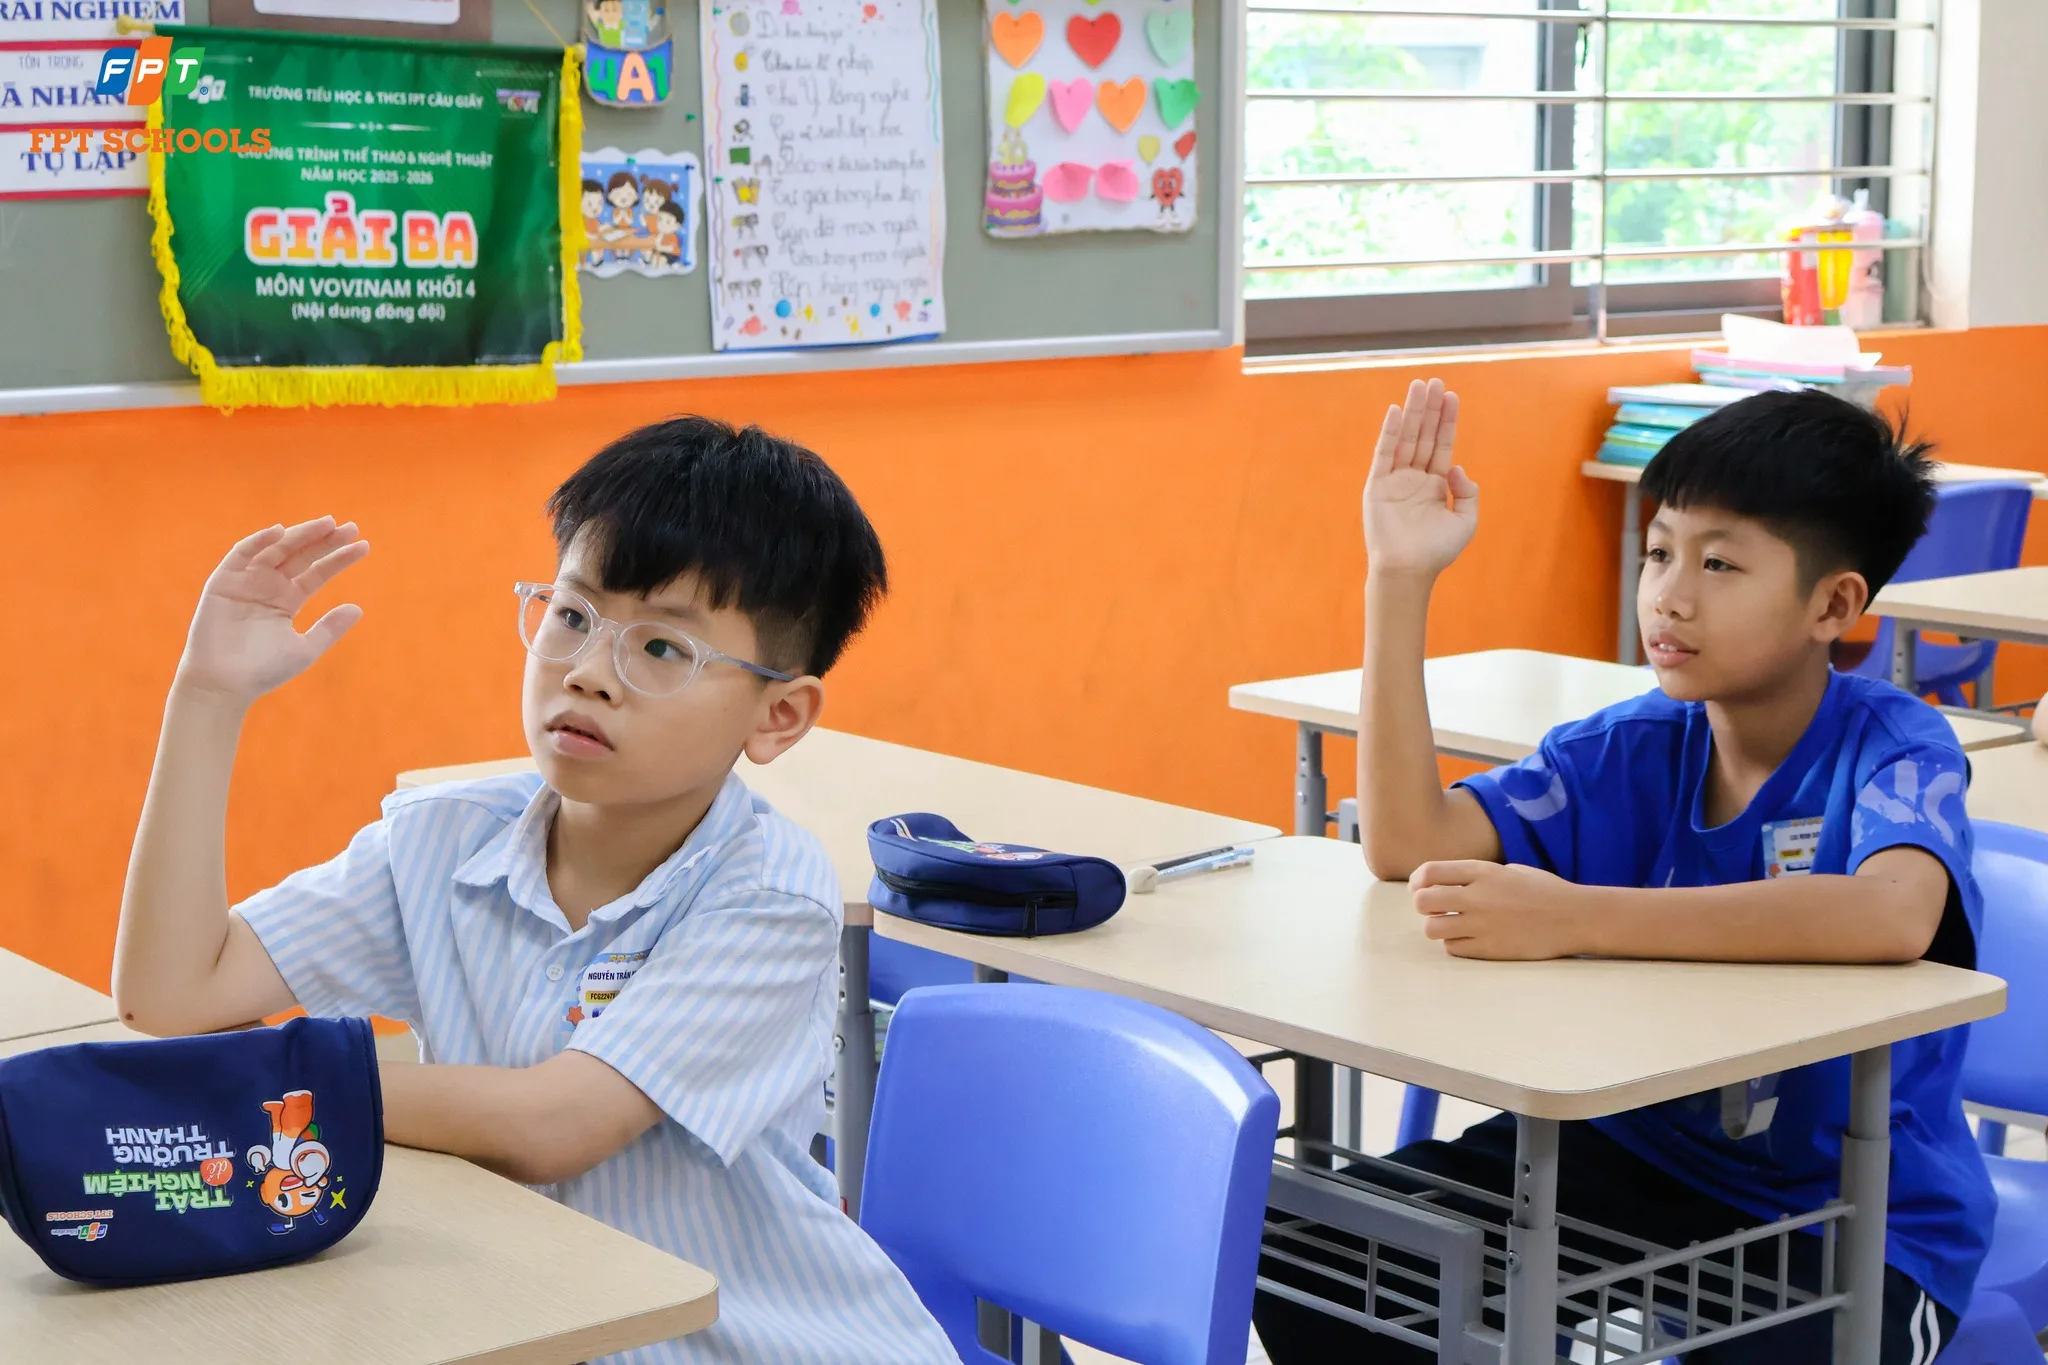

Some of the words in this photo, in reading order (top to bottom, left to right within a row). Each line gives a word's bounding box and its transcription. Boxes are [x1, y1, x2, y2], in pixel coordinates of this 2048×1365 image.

[587, 51, 670, 103] 4A1
[248, 85, 302, 101] TRƯỜNG
[306, 86, 332, 102] TIỂU
[334, 89, 362, 105] HỌC
[364, 91, 374, 103] &
[376, 91, 407, 105] THCS
[427, 92, 453, 107] CẦU
[296, 145, 339, 162] TRÌNH
[343, 145, 370, 163] THỂ
[371, 149, 406, 164] THAO
[407, 151, 416, 164] &
[417, 149, 452, 168] NGHỆ
[455, 151, 494, 169] THUẬT
[300, 165, 334, 182] NĂM
[337, 168, 367, 185] HỌC
[369, 169, 399, 183] 2025
[406, 170, 433, 184] 2026
[247, 194, 395, 264] GIẢI
[405, 214, 476, 265] BA
[255, 272, 305, 297] MÔN
[309, 276, 412, 298] VOVINAM
[416, 273, 463, 298] KHỐI
[465, 279, 476, 298] 4
[292, 303, 325, 322] (Nội
[328, 303, 371, 323] dung
[375, 303, 414, 323] đồng
[417, 303, 446, 322] đội)
[113, 1142, 234, 1168] TRƯỞNG
[83, 1169, 203, 1197] NGHIỆM
[205, 1160, 228, 1183] để
[155, 1188, 233, 1214] TRẢI
[46, 1210, 93, 1222] SCHOOLS
[93, 1209, 113, 1220] FPT
[77, 1222, 108, 1242] FPT
